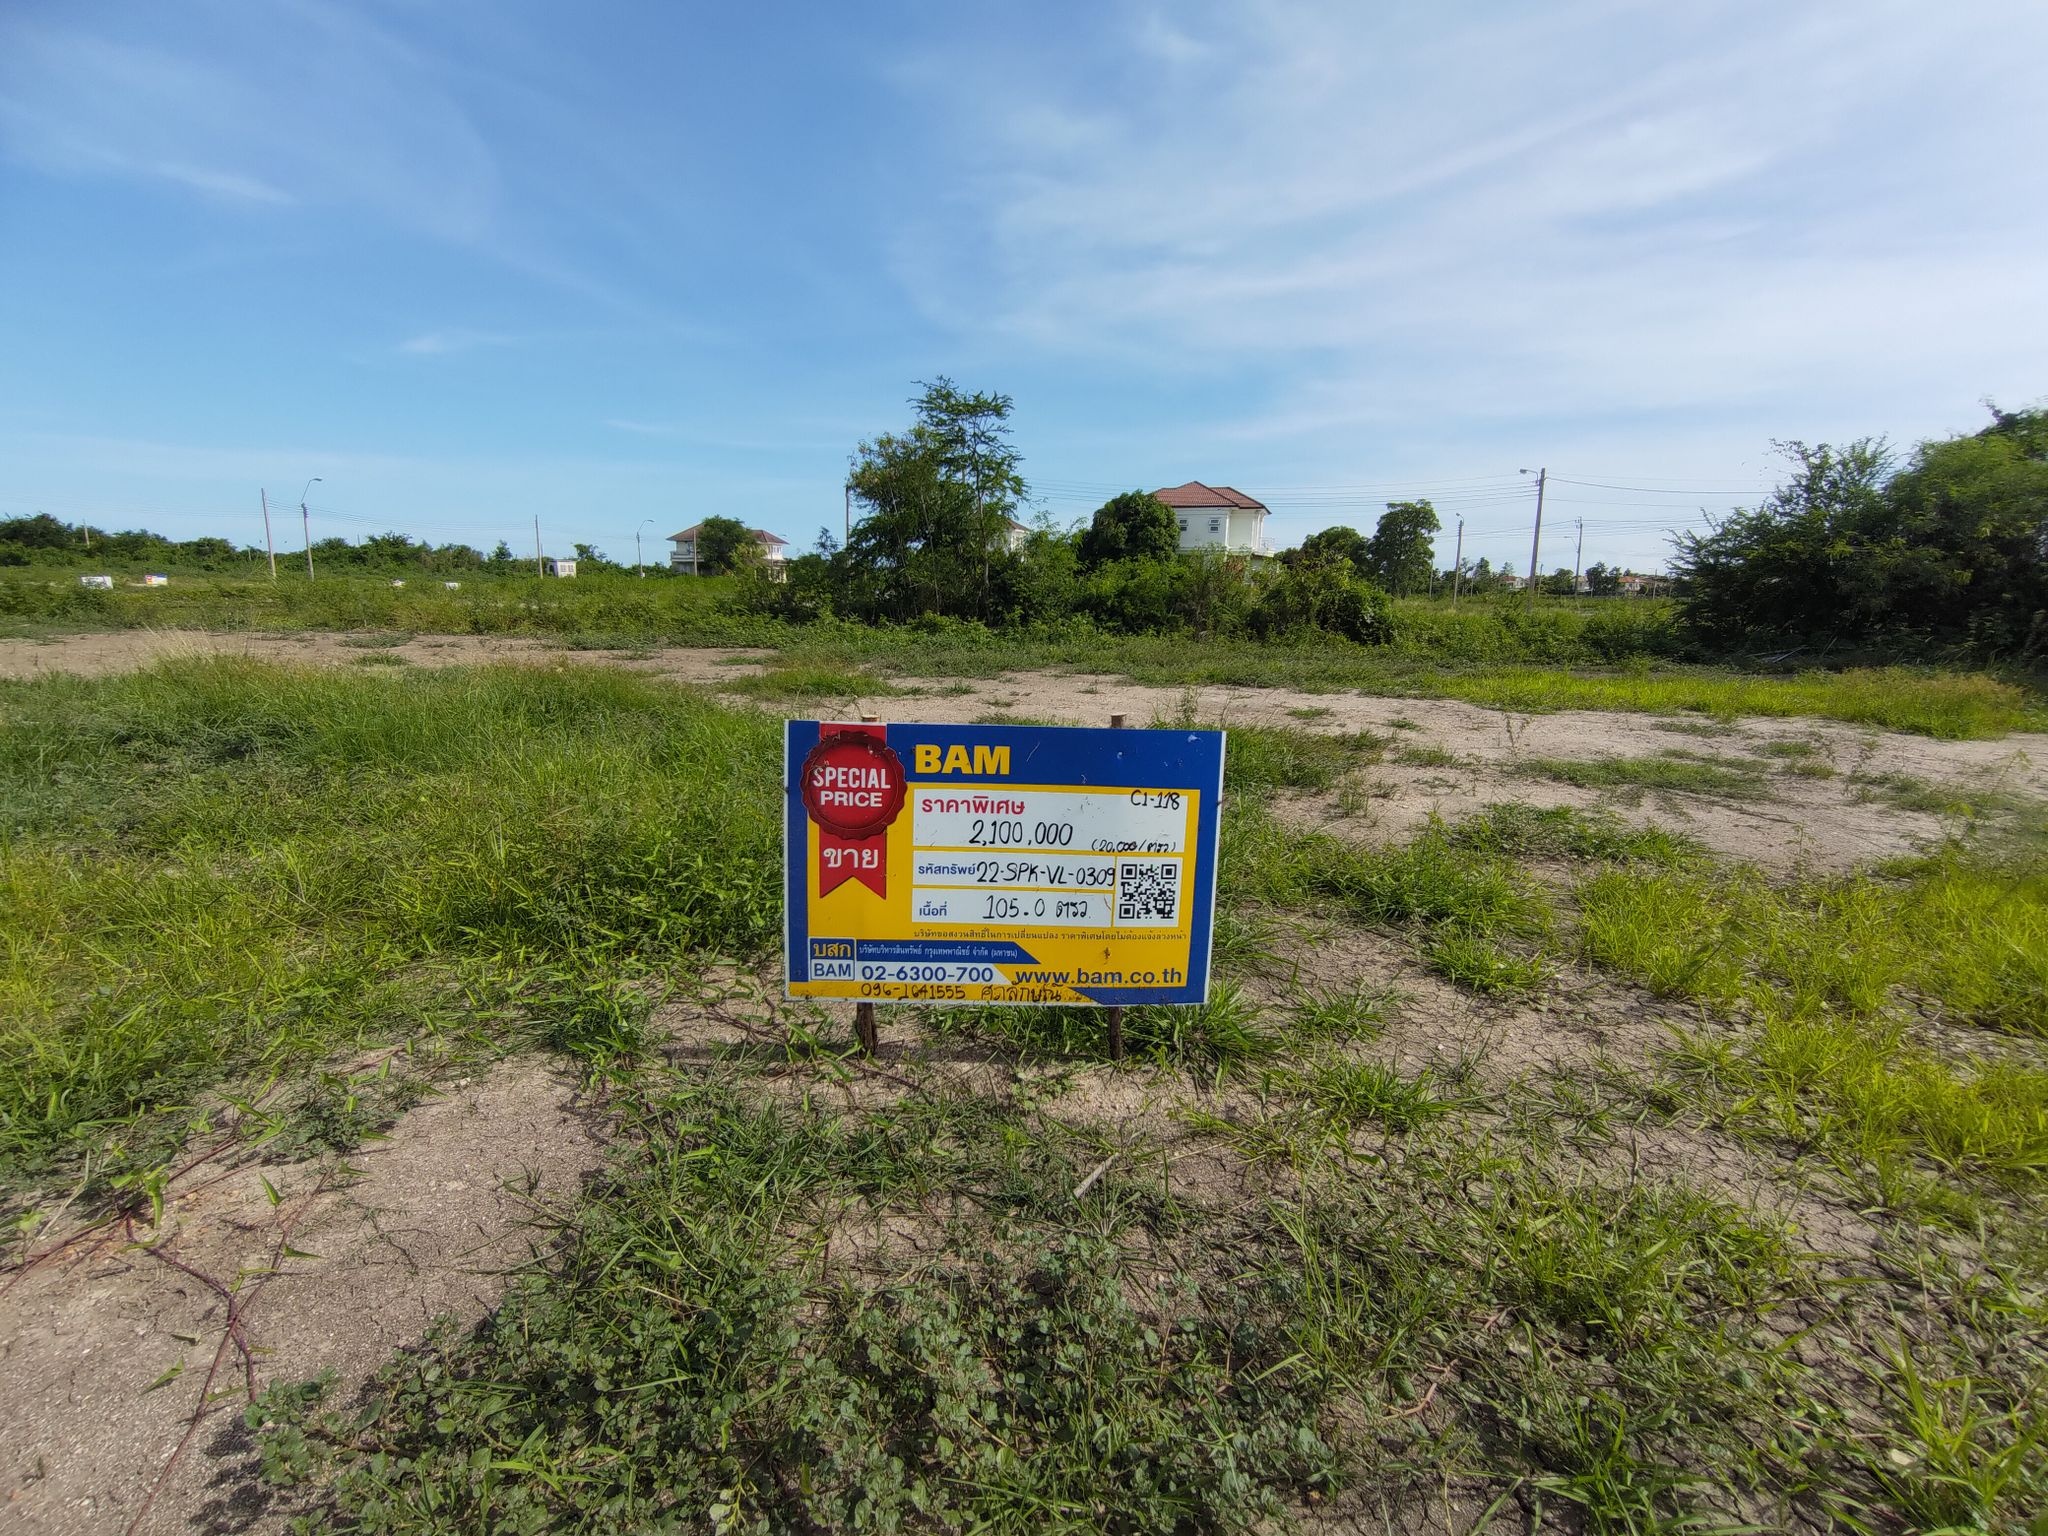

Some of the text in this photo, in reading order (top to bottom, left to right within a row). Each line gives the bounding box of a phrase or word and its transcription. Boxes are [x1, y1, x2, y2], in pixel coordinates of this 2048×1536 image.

[915, 744, 1011, 775] BAM
[813, 767, 891, 789] SPECIAL
[820, 791, 883, 808] PRICE
[921, 796, 1026, 815] ราคาพิเศษ
[968, 819, 1073, 847] 2,100,000
[823, 848, 879, 869] ขาย
[918, 862, 976, 876] รหัสทรัพย์
[919, 901, 948, 917] เนื้อที่
[813, 942, 852, 958] บสก
[814, 964, 852, 978] BAM
[861, 966, 994, 982] 02-6300-700
[1015, 968, 1182, 984] www.bam.co.th
